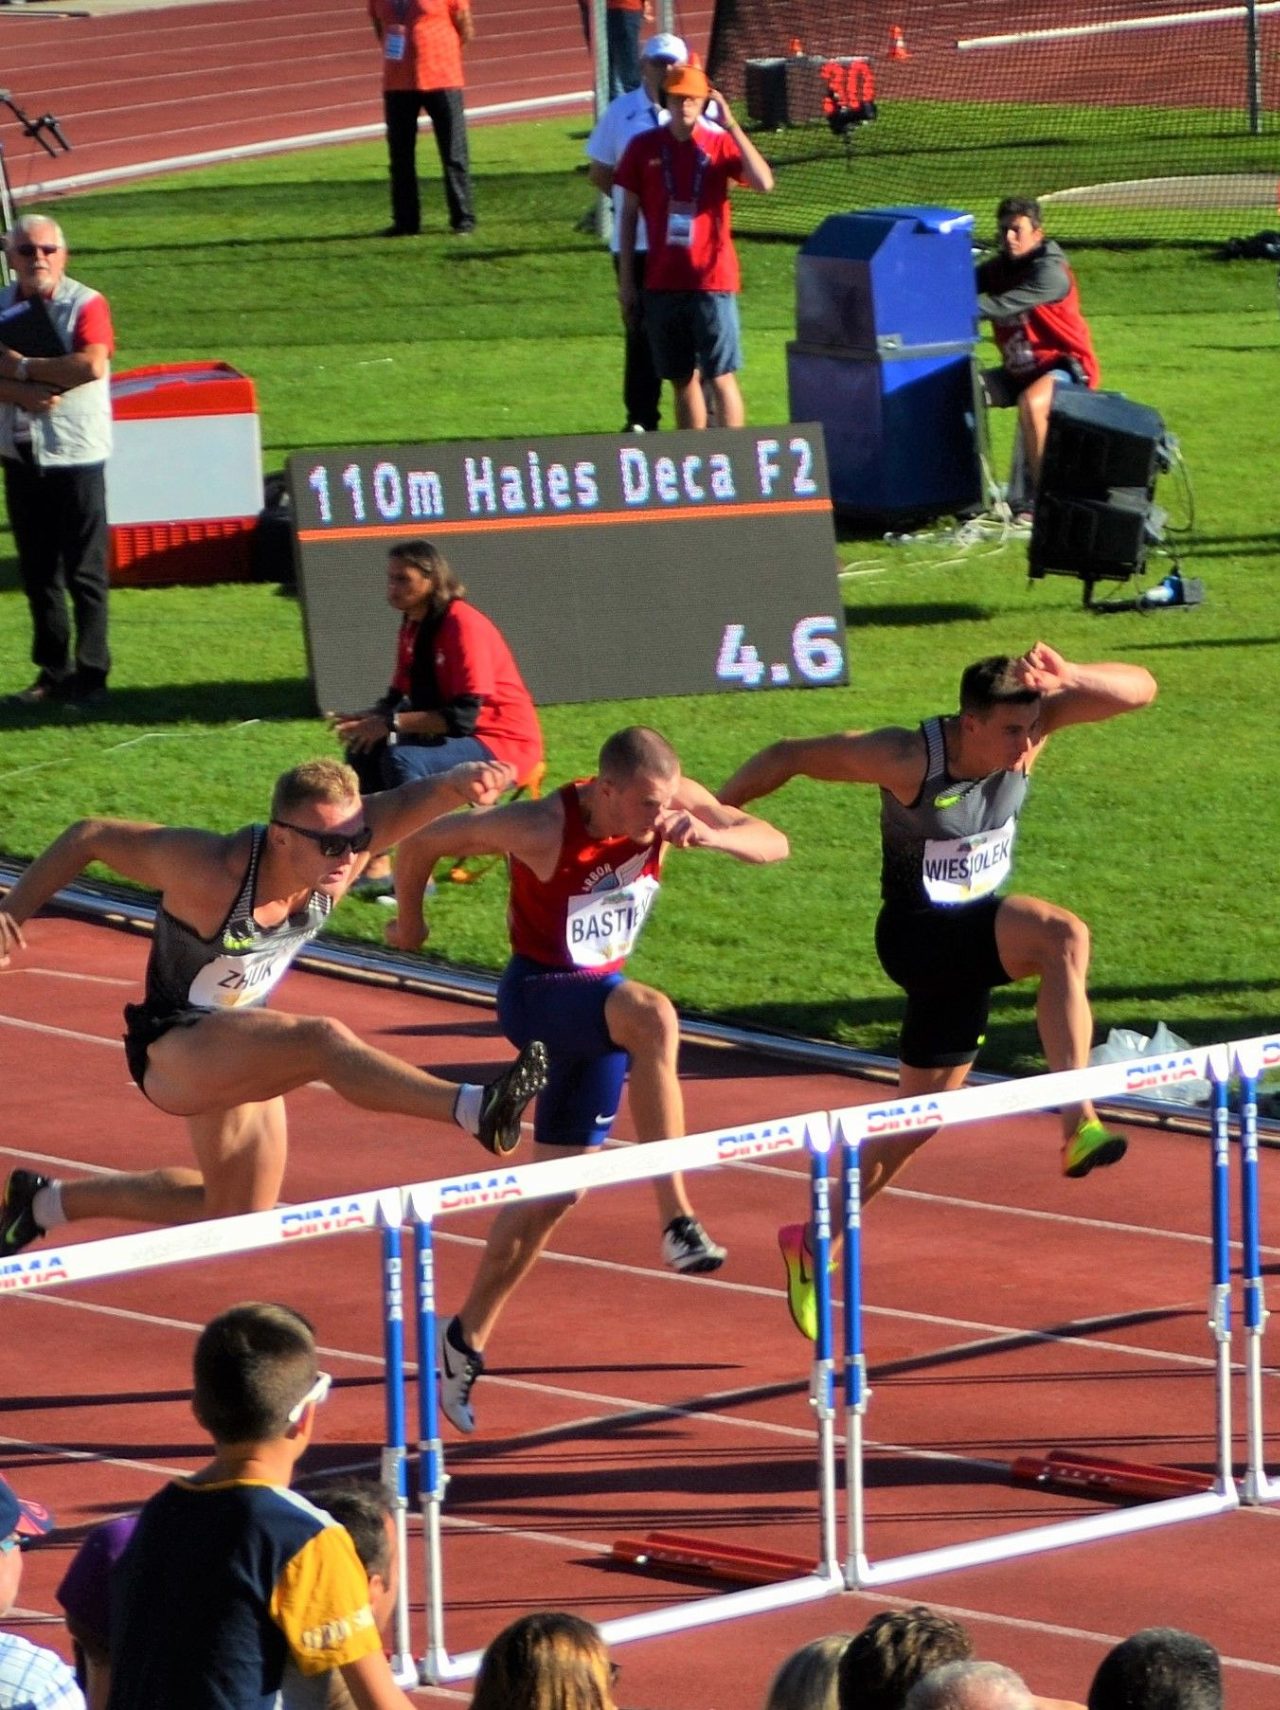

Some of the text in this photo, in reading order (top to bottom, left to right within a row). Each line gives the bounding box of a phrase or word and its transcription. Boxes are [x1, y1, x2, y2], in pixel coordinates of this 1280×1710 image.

[308, 437, 818, 524] 110m Haies Deca F2
[714, 614, 845, 686] 4.6
[1126, 1056, 1198, 1089] DIMA
[866, 1101, 944, 1132] DIMA
[717, 1125, 795, 1159] DIMA
[440, 1175, 523, 1209] DIMA
[281, 1203, 365, 1238] DIMA
[0, 1256, 68, 1289] IMA
